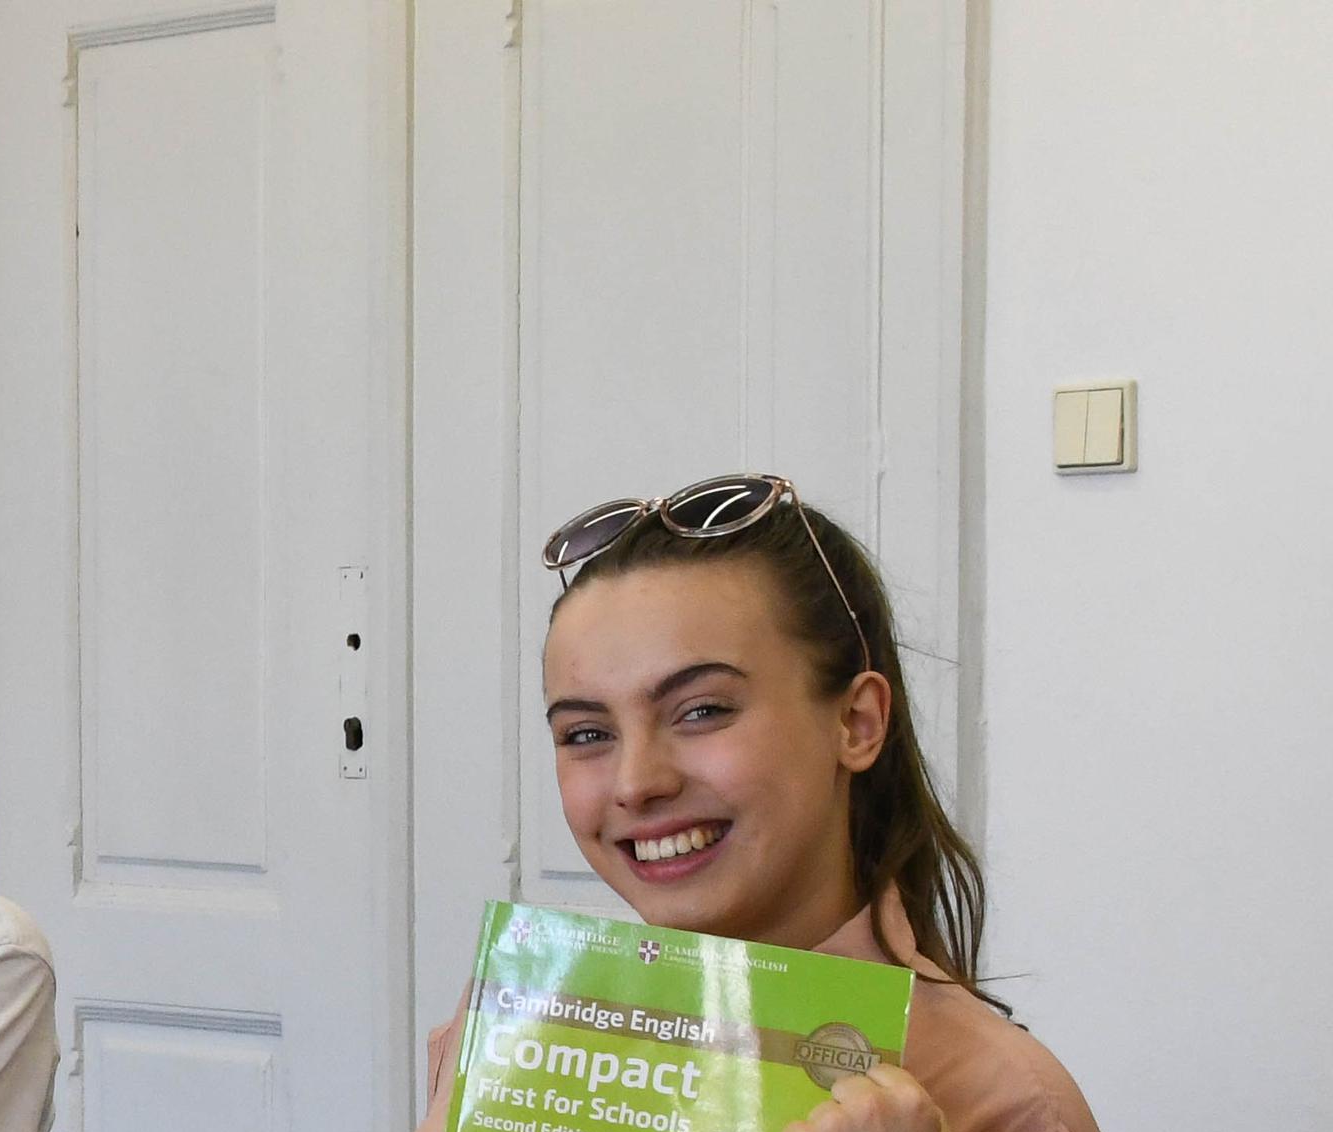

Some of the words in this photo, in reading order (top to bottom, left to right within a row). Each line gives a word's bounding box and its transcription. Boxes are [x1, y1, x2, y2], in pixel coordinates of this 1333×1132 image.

[497, 987, 624, 1030] Cambridge
[630, 1010, 715, 1043] English
[484, 1024, 701, 1099] Compact
[478, 1077, 537, 1108] First
[544, 1089, 583, 1116] for
